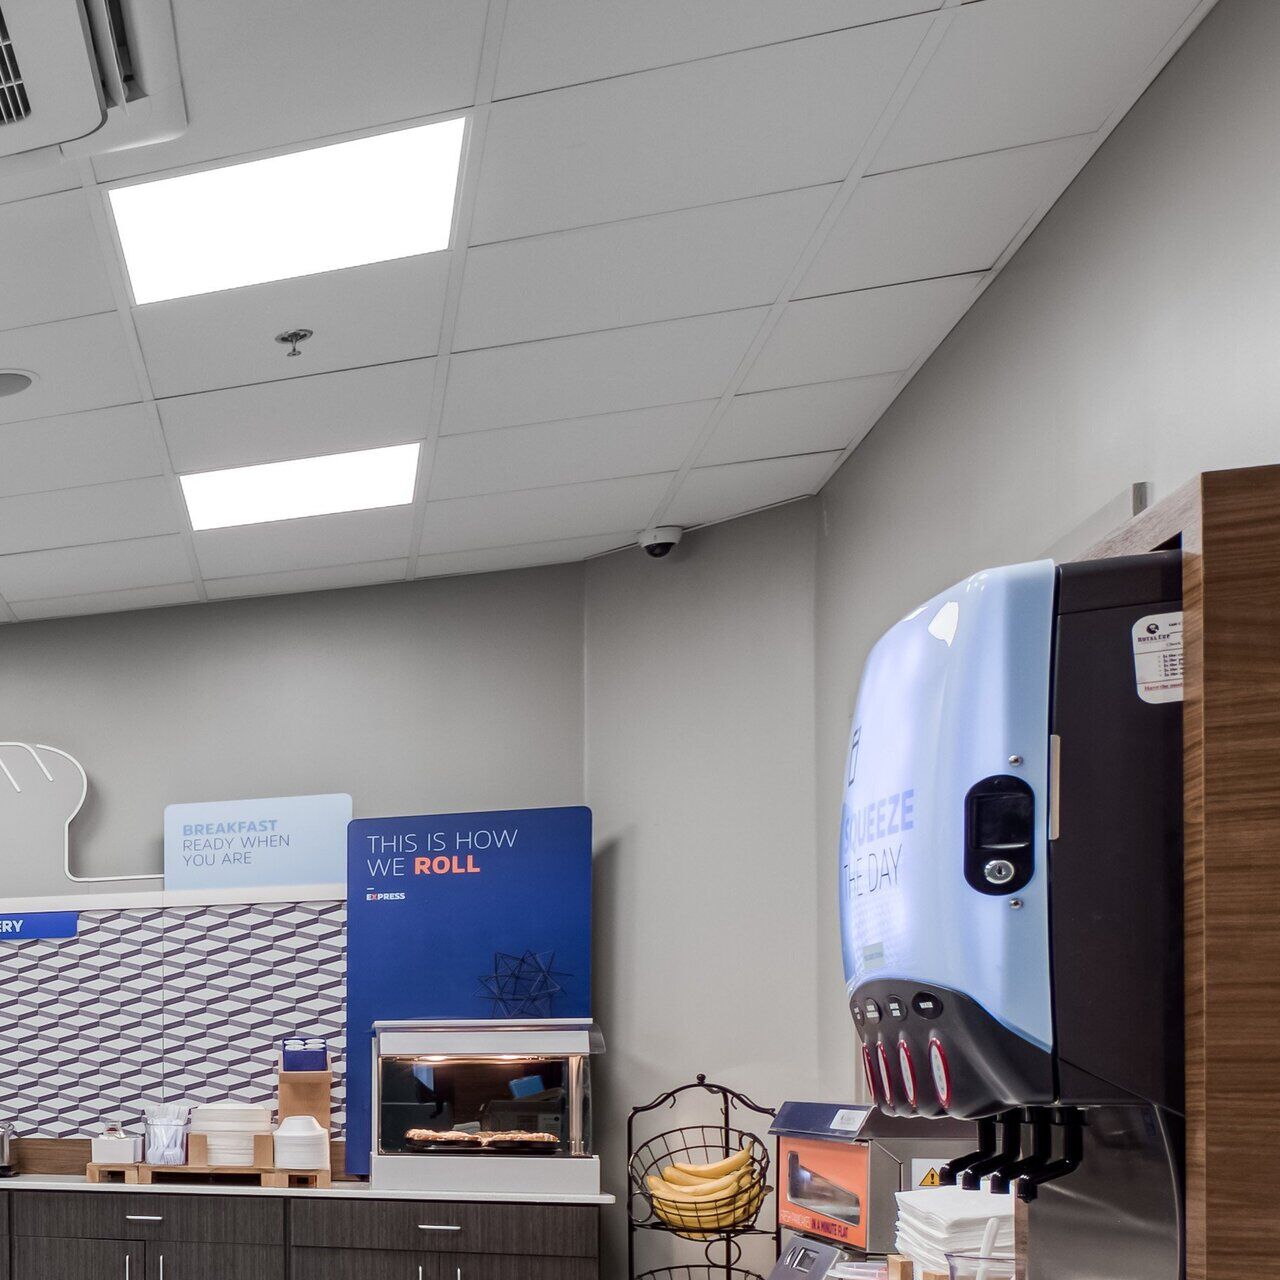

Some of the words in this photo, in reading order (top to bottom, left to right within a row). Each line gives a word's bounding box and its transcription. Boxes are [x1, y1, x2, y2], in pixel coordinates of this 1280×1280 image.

[183, 819, 278, 836] BREAKFAST
[183, 836, 234, 853] READY
[240, 833, 290, 849] WHEN
[367, 833, 417, 854] THIS
[427, 831, 446, 852] IS
[456, 829, 518, 850] HOW
[183, 853, 218, 867] YOU
[221, 851, 252, 866] ARE
[367, 857, 405, 877] WE
[414, 855, 480, 875] ROLL
[869, 843, 903, 893] DAY
[366, 892, 406, 901] EXPRESS
